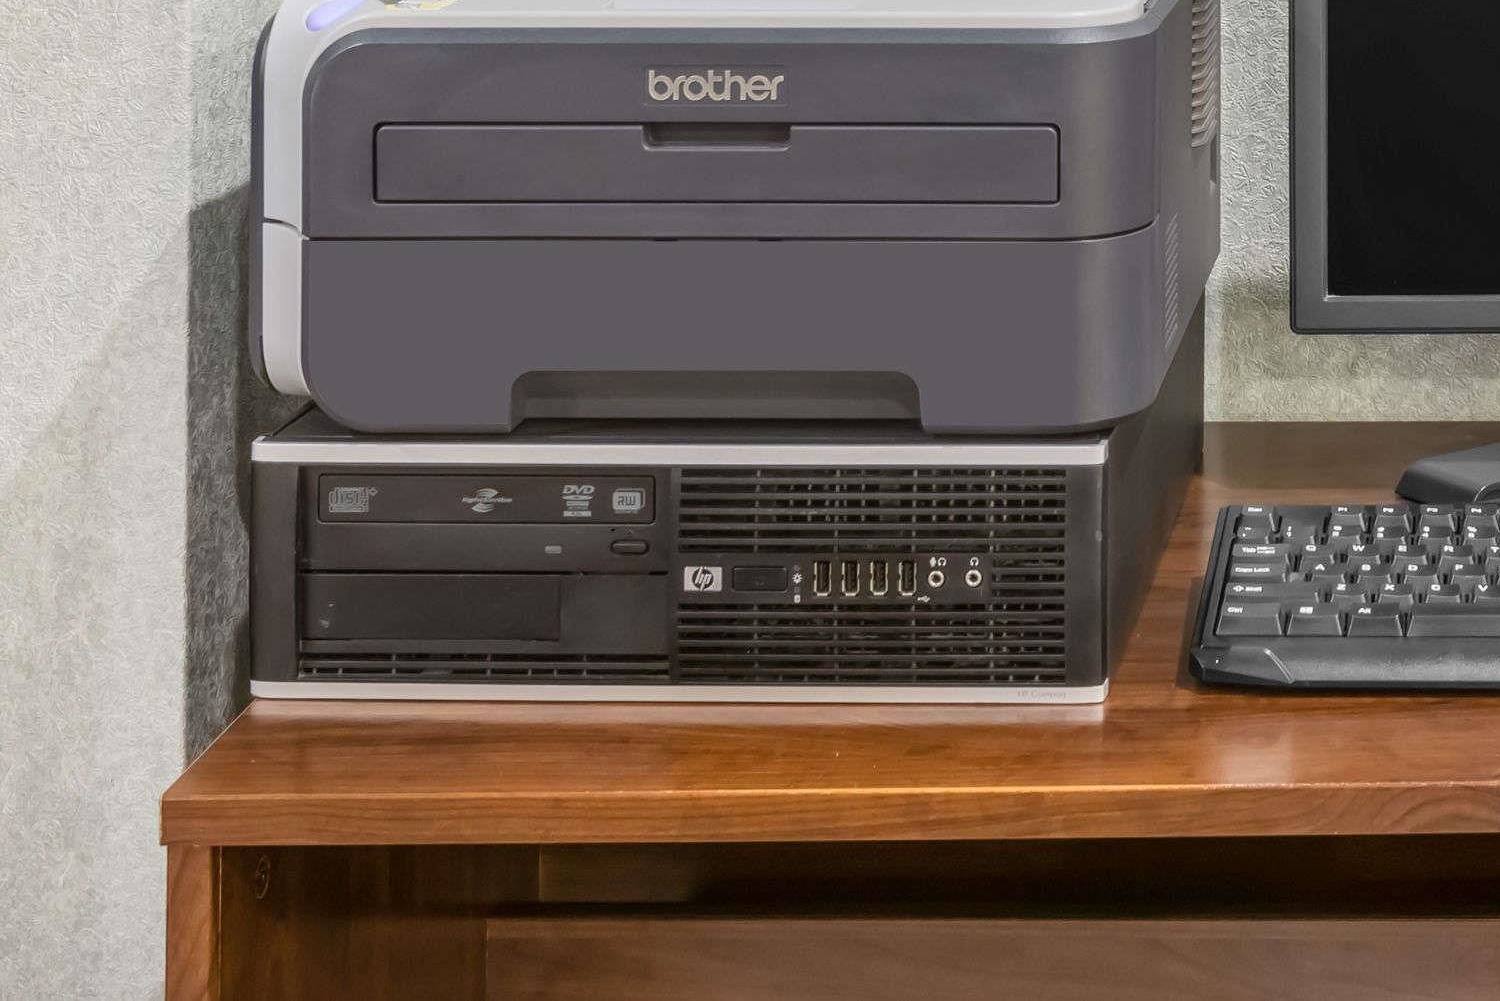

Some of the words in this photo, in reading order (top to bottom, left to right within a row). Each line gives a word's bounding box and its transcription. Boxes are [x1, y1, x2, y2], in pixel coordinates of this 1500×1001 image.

[648, 69, 785, 101] brother
[562, 485, 595, 494] DVD
[694, 566, 712, 591] hp
